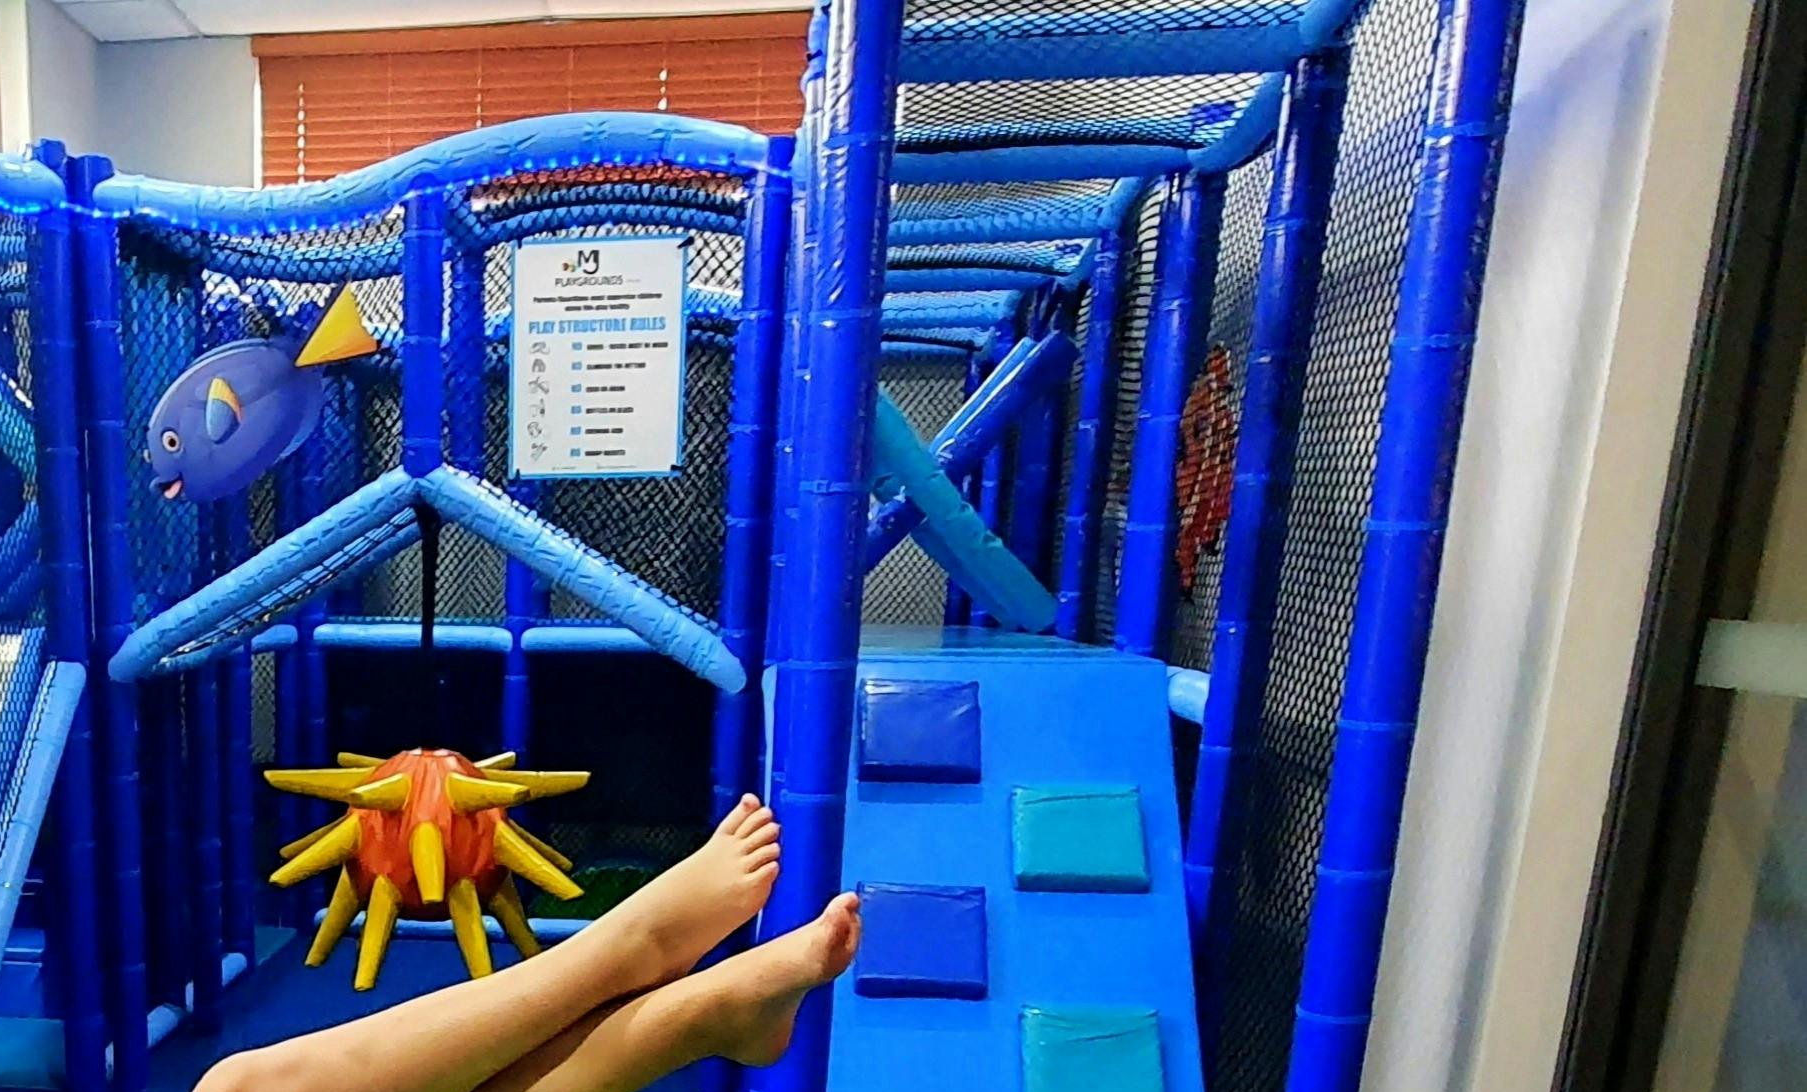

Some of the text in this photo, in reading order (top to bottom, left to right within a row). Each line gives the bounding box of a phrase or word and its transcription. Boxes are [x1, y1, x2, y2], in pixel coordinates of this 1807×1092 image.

[554, 275, 624, 287] PLAYGROUNDS
[528, 316, 666, 334] PLAY STRUCTURE RULES
